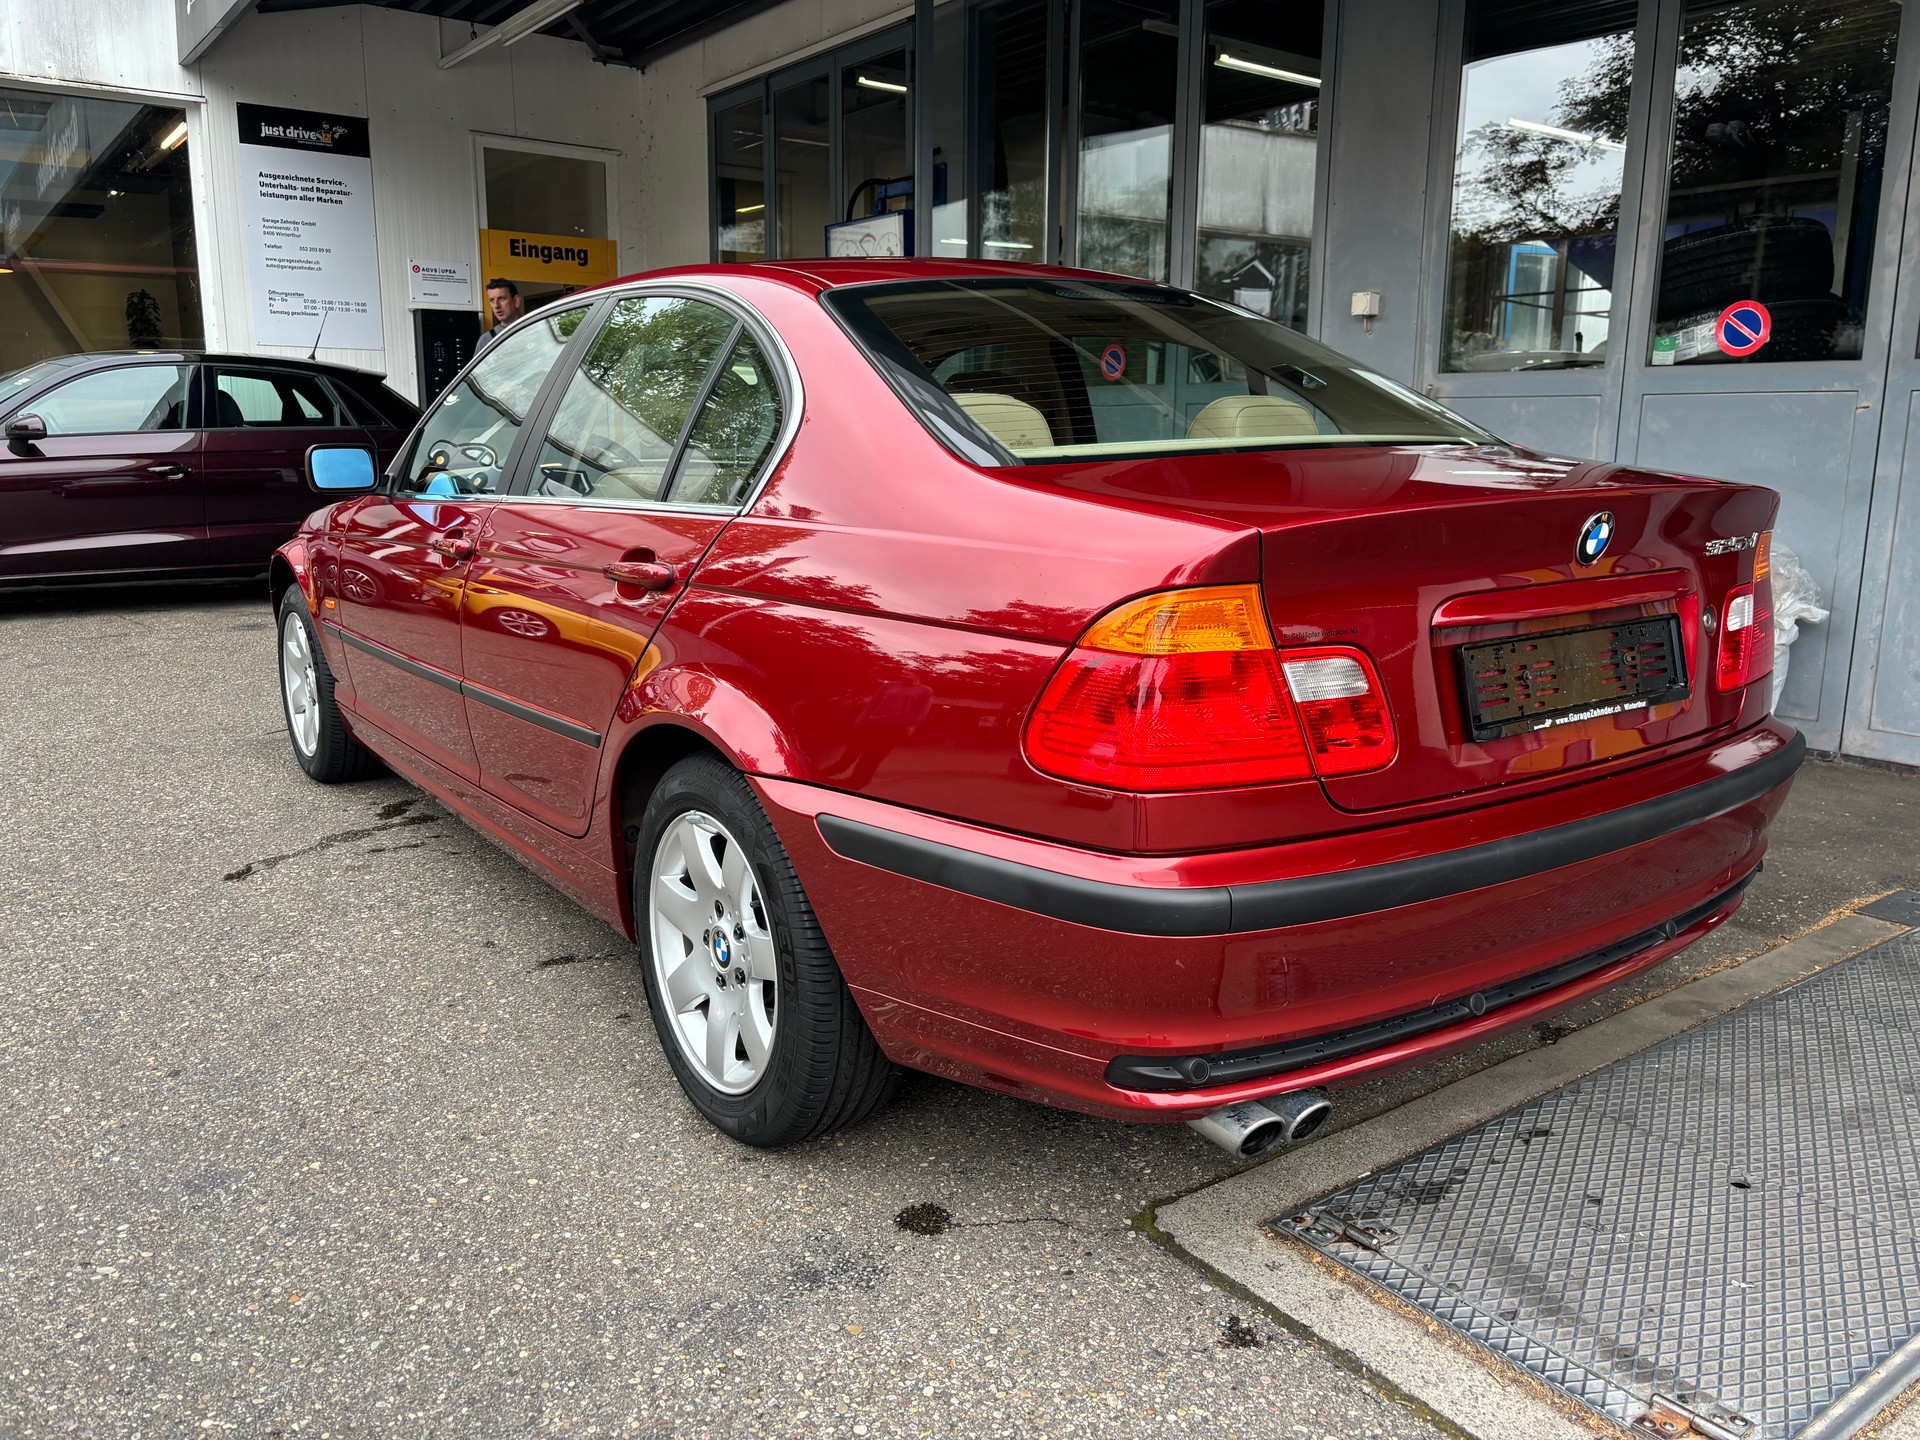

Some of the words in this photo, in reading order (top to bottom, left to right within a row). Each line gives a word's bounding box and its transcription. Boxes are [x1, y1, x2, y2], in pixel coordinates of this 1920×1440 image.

[260, 122, 284, 137] just
[286, 126, 317, 140] drive
[258, 171, 315, 184] Ausgezeichnete
[316, 177, 348, 188] Service-,
[259, 181, 299, 191] Unterhalts-
[300, 184, 314, 193] und
[316, 187, 353, 198] Reparatur-
[260, 190, 297, 201] leistungen
[299, 194, 315, 202] aller
[316, 196, 343, 205] Marken
[280, 218, 300, 226] Zehnder
[265, 256, 320, 266] www.garagezehnder.ch
[509, 239, 588, 267] Eingang
[268, 290, 304, 298] Öffnungszeiten
[1291, 631, 1320, 640] Schläpfer
[1556, 704, 1622, 724] www.GarageZehnder.ch
[1624, 700, 1647, 711] Winterthur
